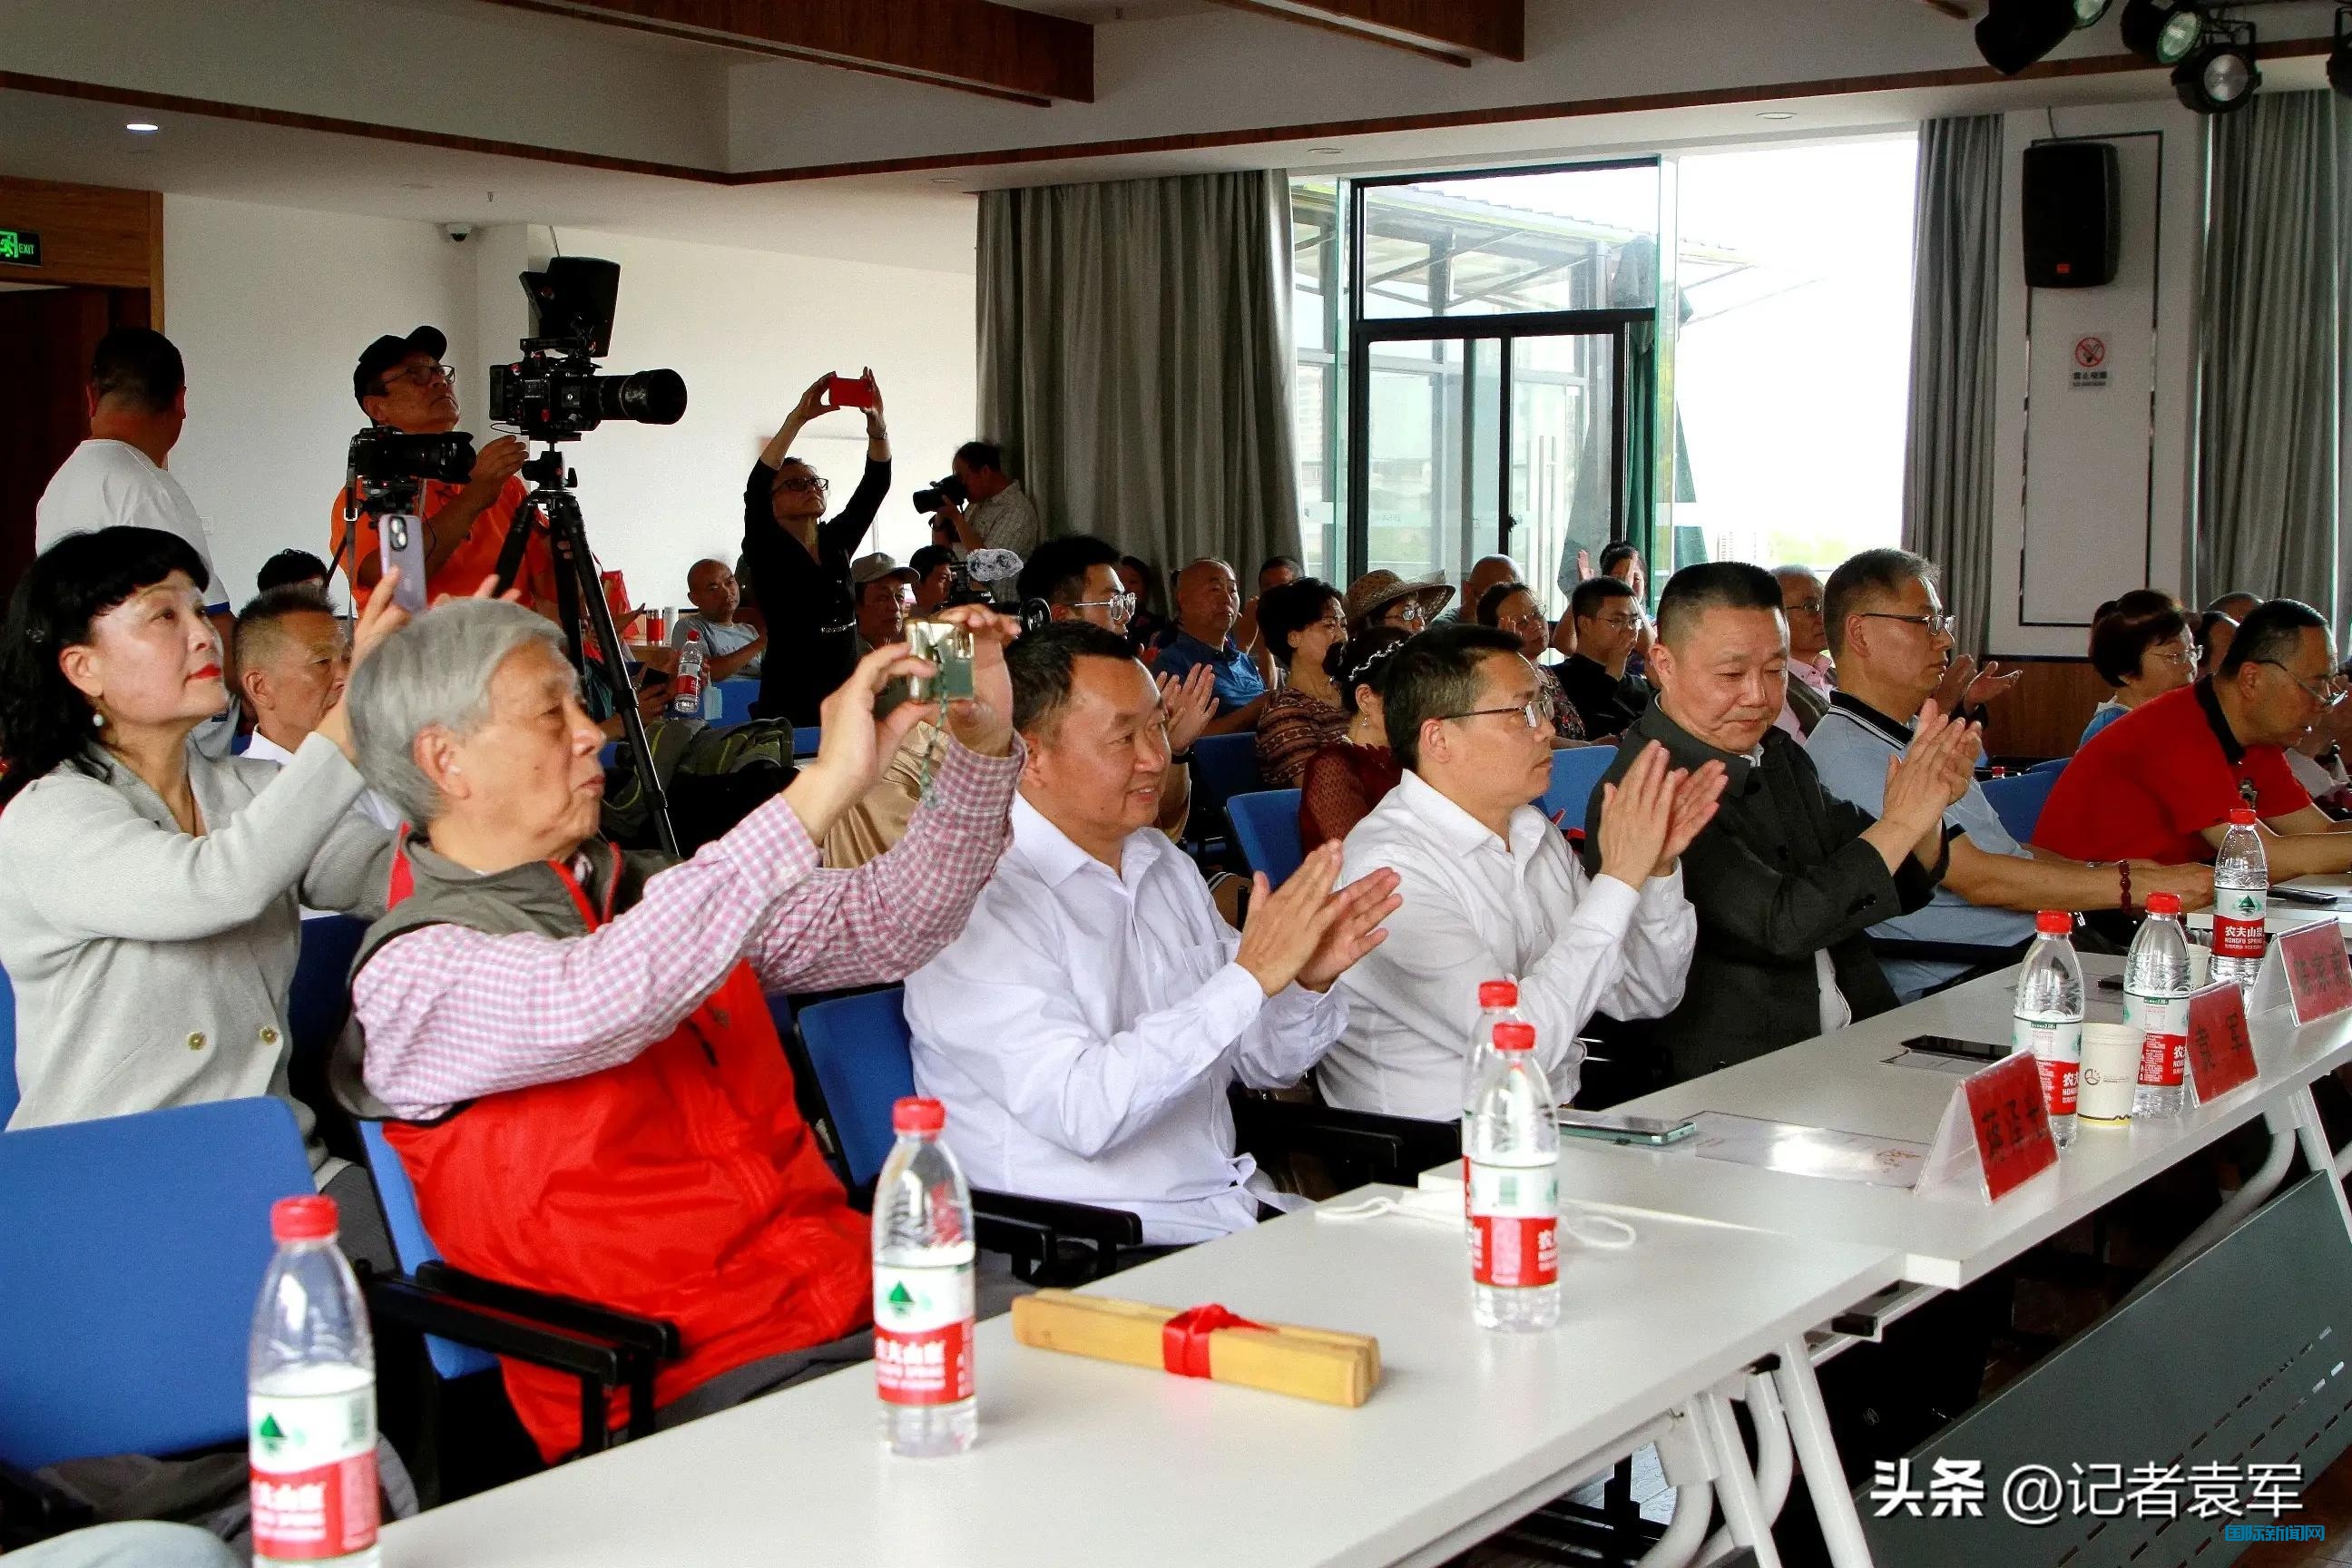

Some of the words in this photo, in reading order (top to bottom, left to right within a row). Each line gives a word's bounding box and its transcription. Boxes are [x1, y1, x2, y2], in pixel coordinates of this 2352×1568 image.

[18, 243, 34, 254] EXIT
[2224, 926, 2263, 937] 农夫山泉
